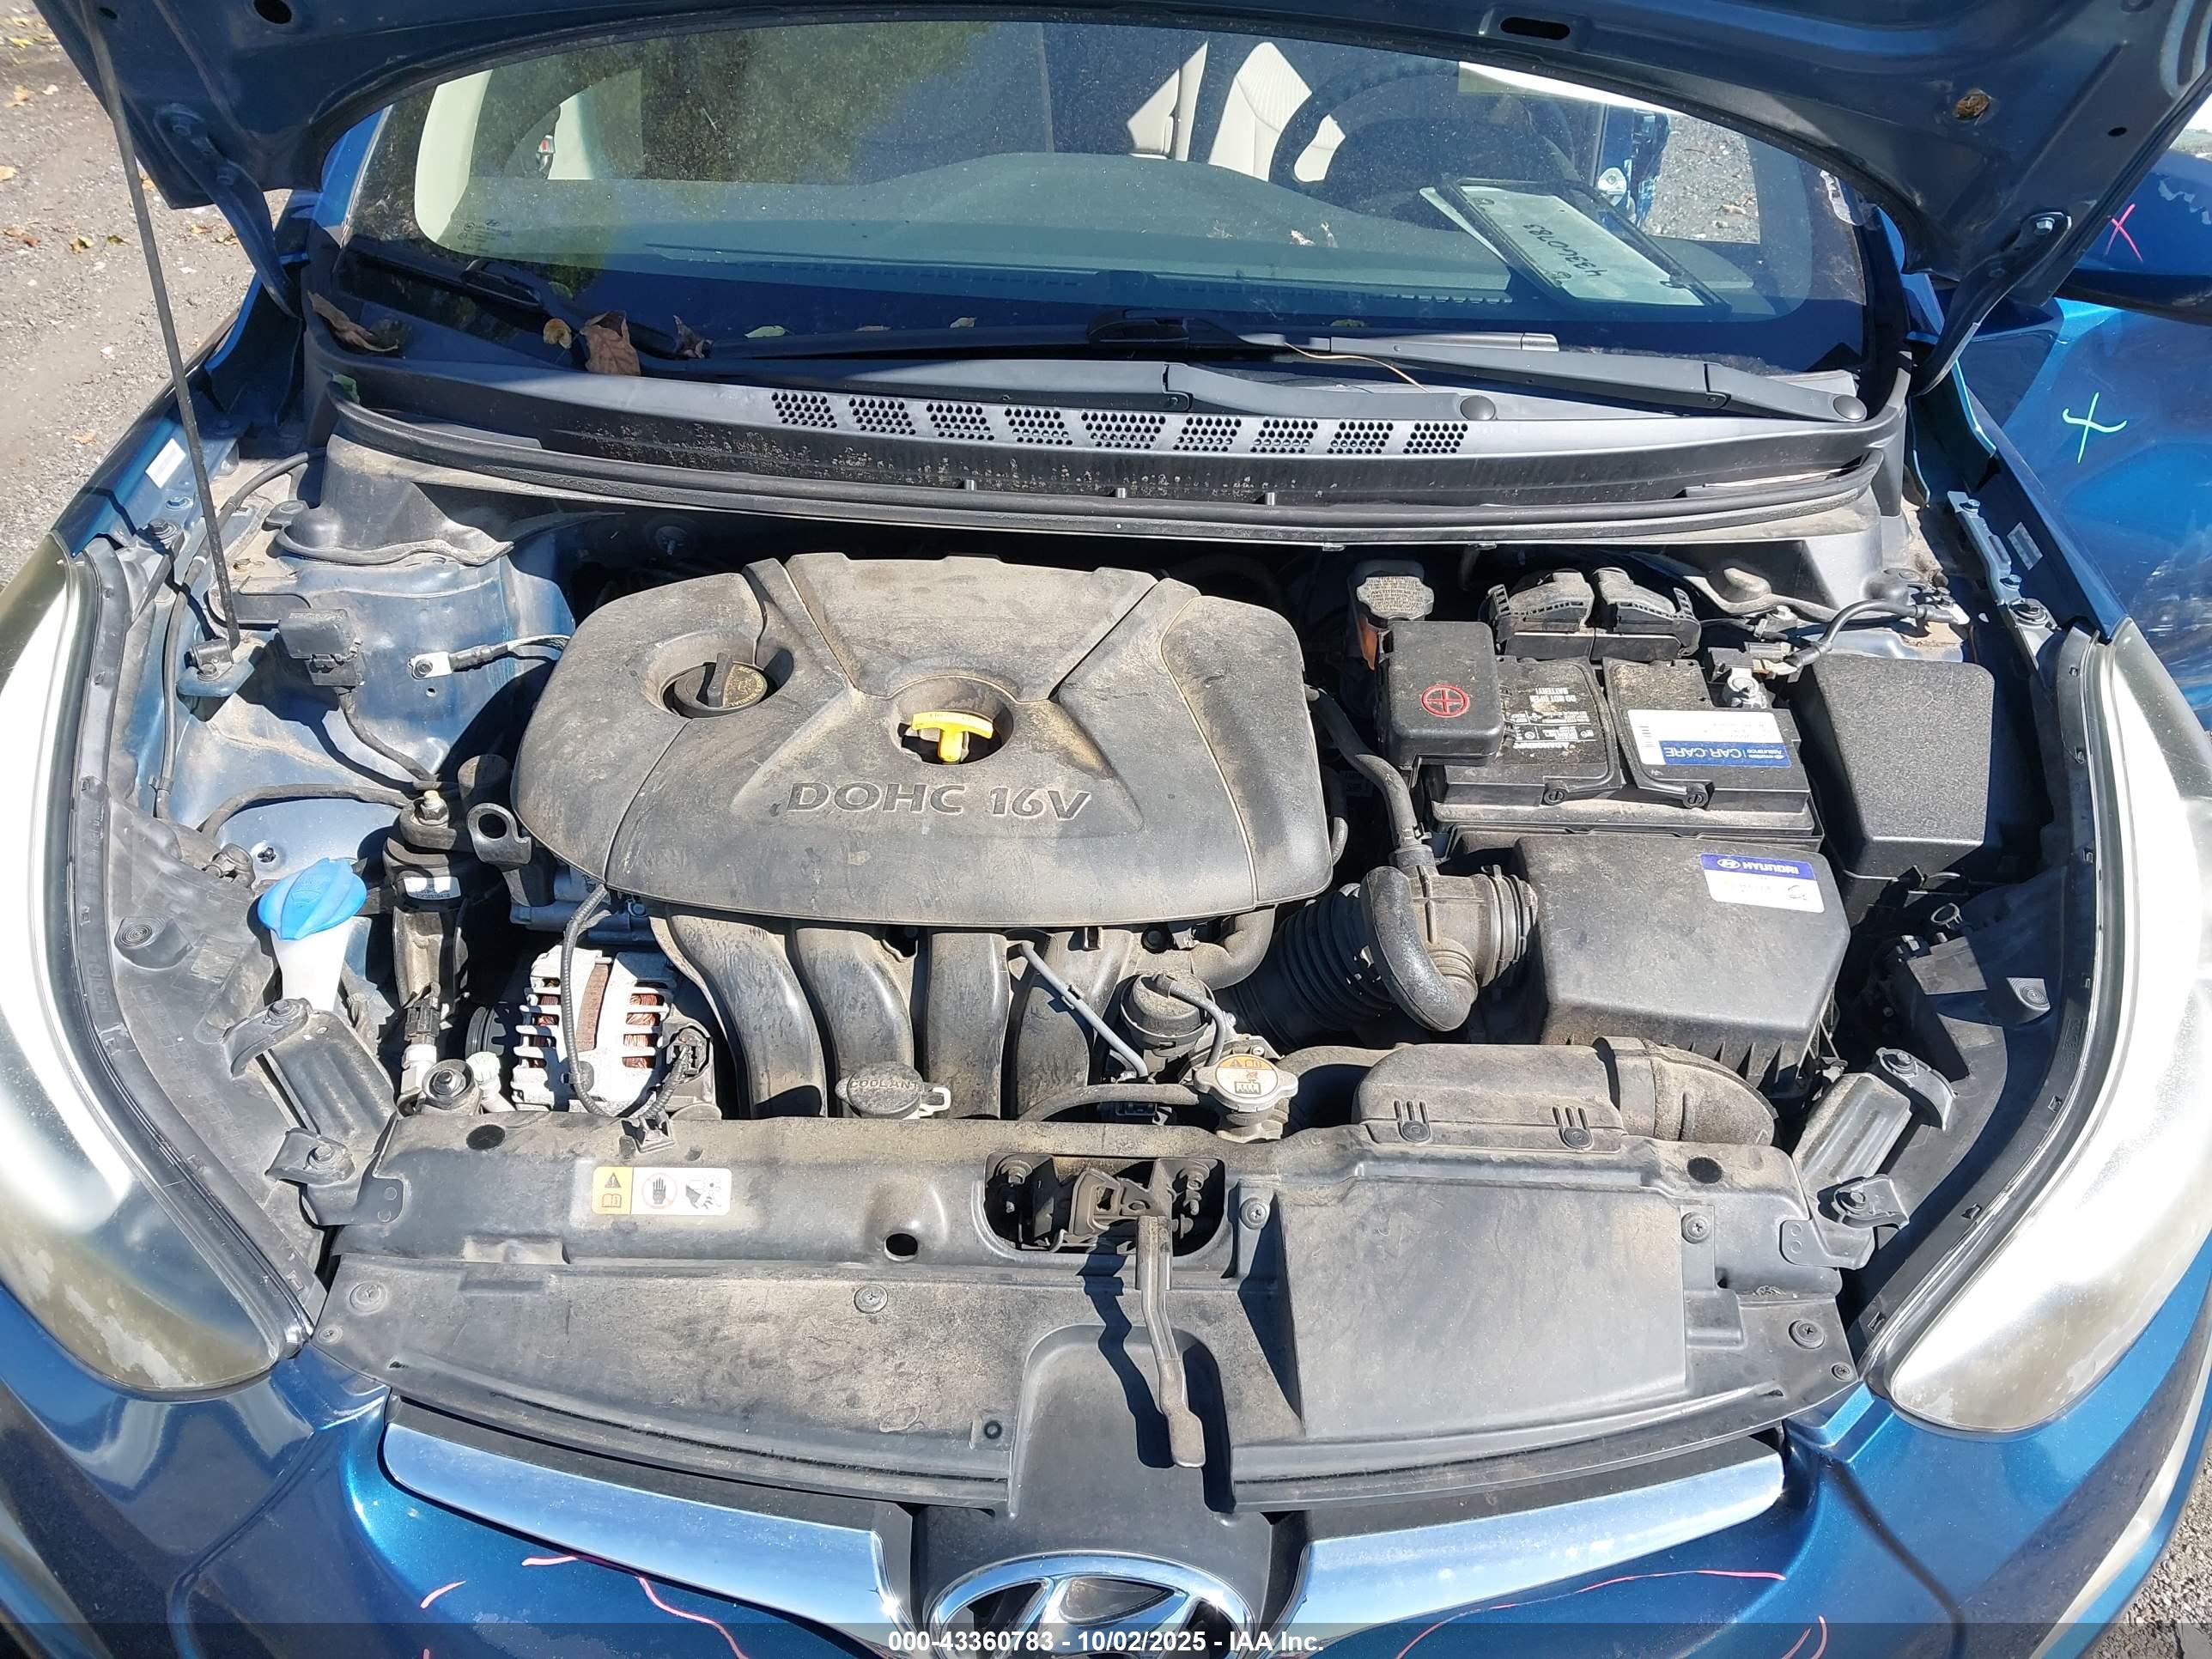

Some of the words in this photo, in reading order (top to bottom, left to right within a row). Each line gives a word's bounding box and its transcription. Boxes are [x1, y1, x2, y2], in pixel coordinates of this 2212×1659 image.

[1522, 223, 1608, 277] 43360783
[1663, 747, 1705, 758] CARE
[1709, 748, 1742, 758] CAR
[785, 781, 966, 814] DOHC
[989, 787, 1092, 821] 16V
[1741, 861, 1801, 875] HYUNDAI
[849, 1079, 919, 1091] COOLANT
